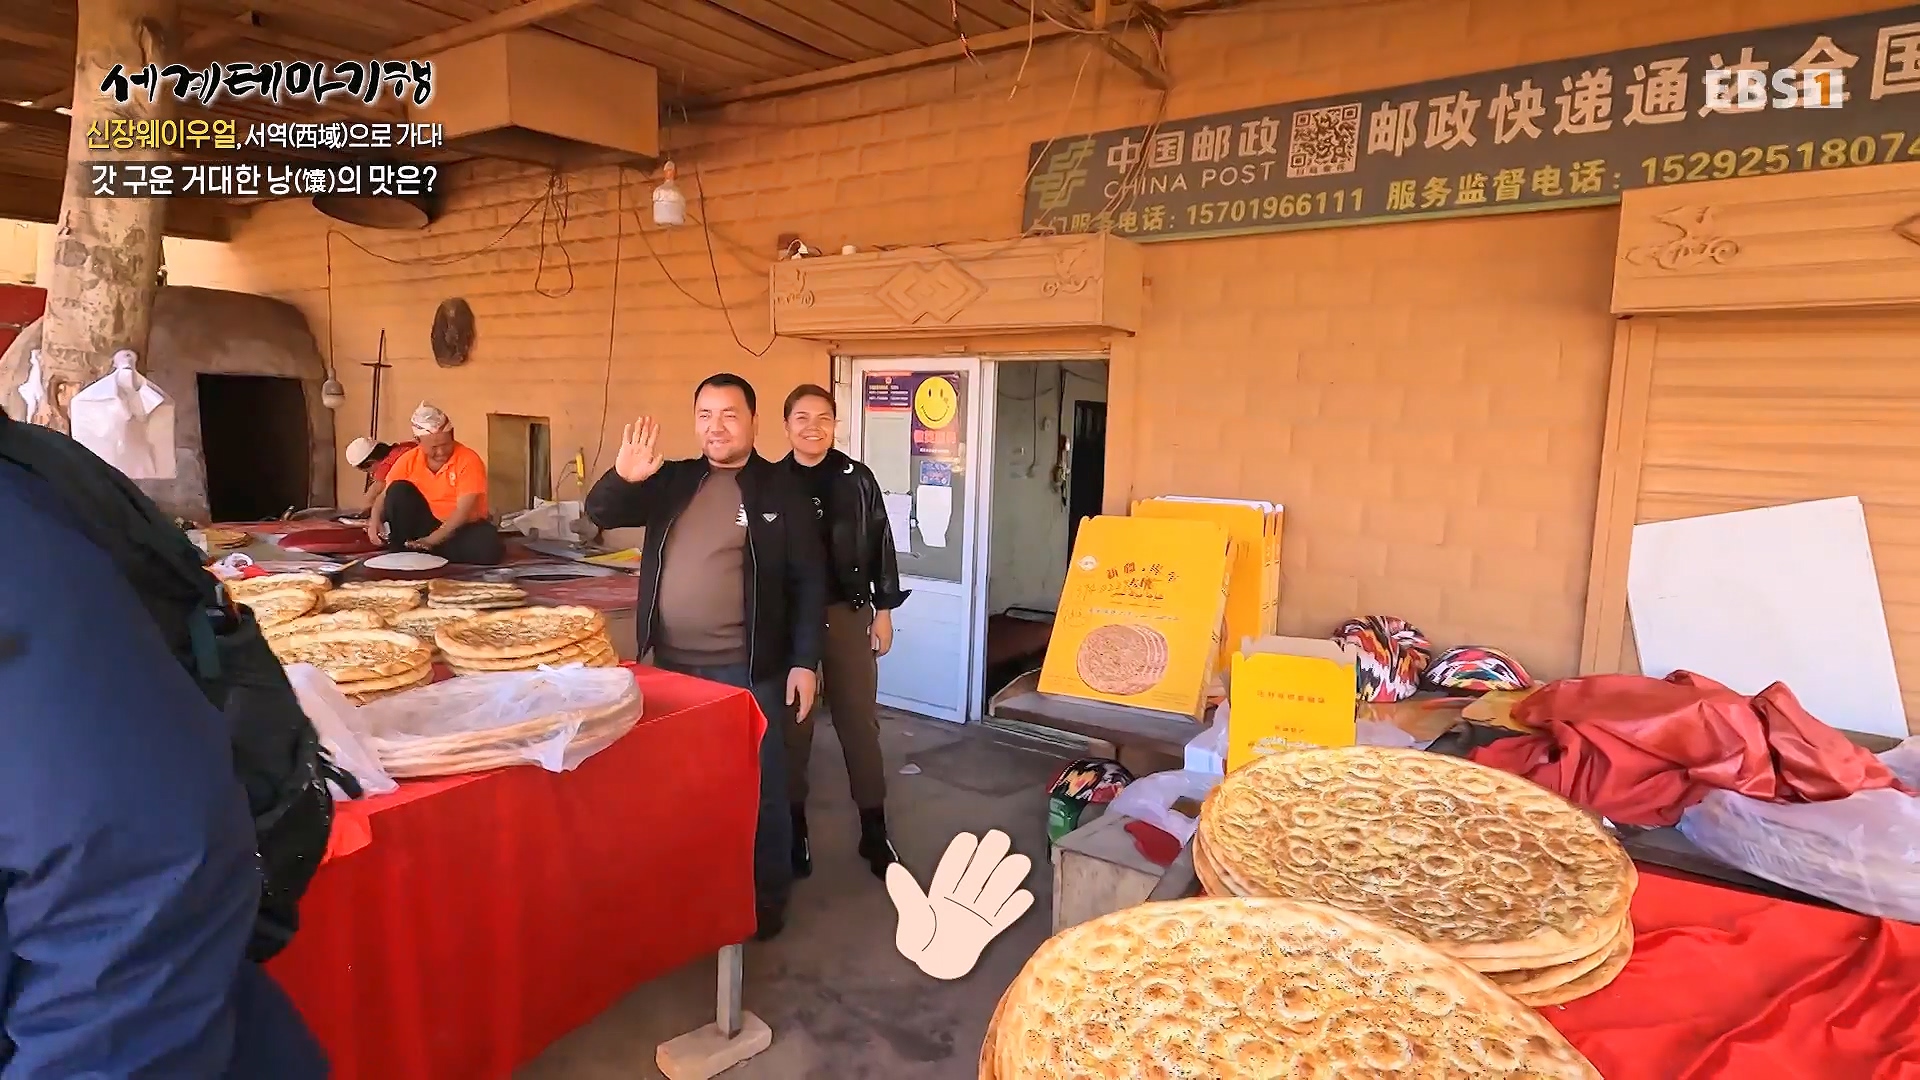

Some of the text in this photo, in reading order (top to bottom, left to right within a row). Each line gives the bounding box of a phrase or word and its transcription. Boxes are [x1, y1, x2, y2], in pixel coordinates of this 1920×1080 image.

[1106, 115, 1281, 175] 中国邮政
[1104, 174, 1188, 200] CHINA
[1201, 160, 1276, 188] POST
[1186, 187, 1364, 226] 15701966111
